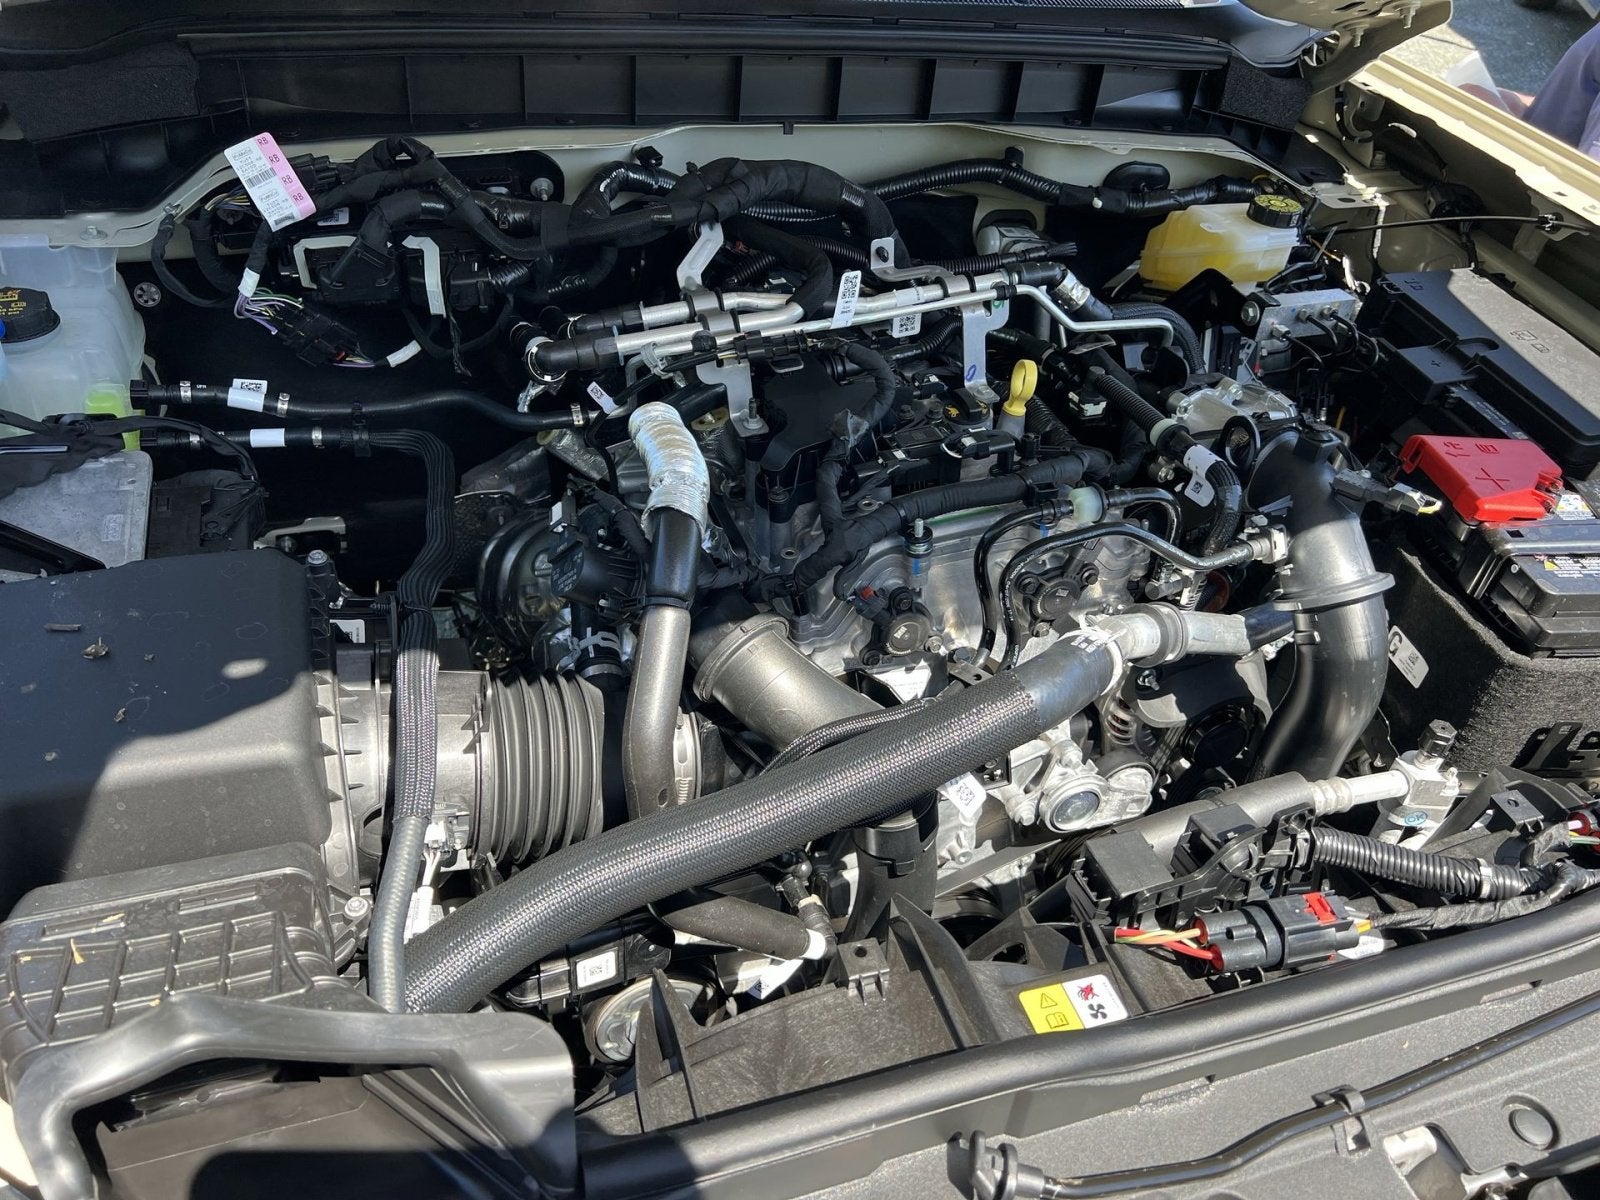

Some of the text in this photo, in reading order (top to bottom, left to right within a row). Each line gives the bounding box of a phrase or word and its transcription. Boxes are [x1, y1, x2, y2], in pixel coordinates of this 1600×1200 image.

[268, 154, 280, 164] RB
[281, 175, 294, 185] RB
[293, 192, 304, 202] RB
